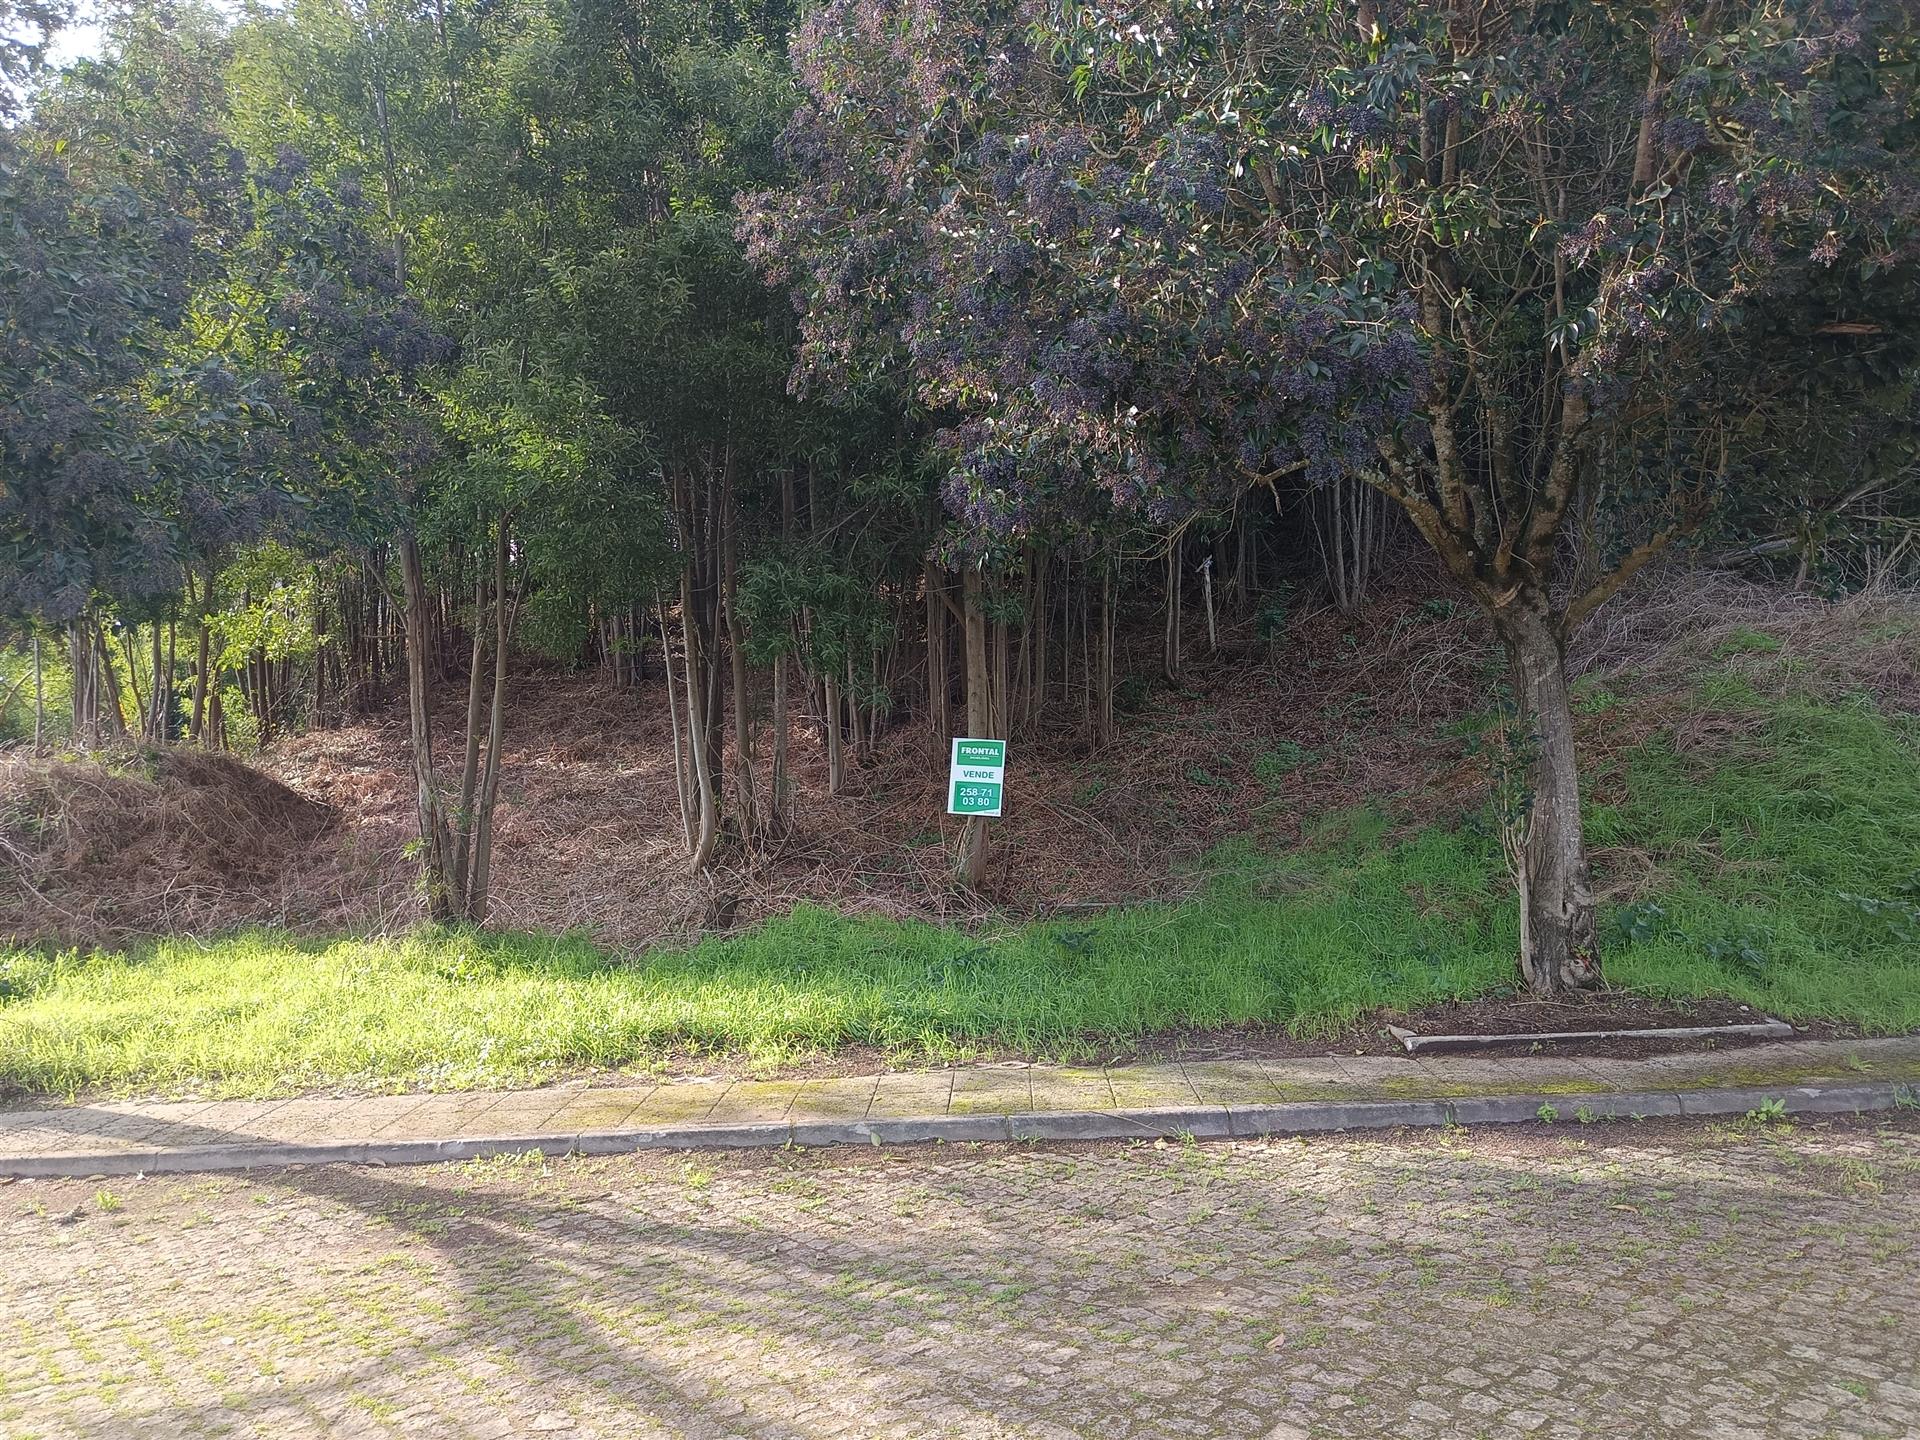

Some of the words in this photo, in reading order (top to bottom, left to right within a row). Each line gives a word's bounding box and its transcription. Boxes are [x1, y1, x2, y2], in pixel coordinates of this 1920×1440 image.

[961, 747, 999, 755] FRONTAL
[963, 770, 994, 779] VENDE
[960, 788, 978, 796] 258
[981, 788, 993, 797] 71
[962, 797, 974, 805] 03
[977, 798, 990, 806] 80
